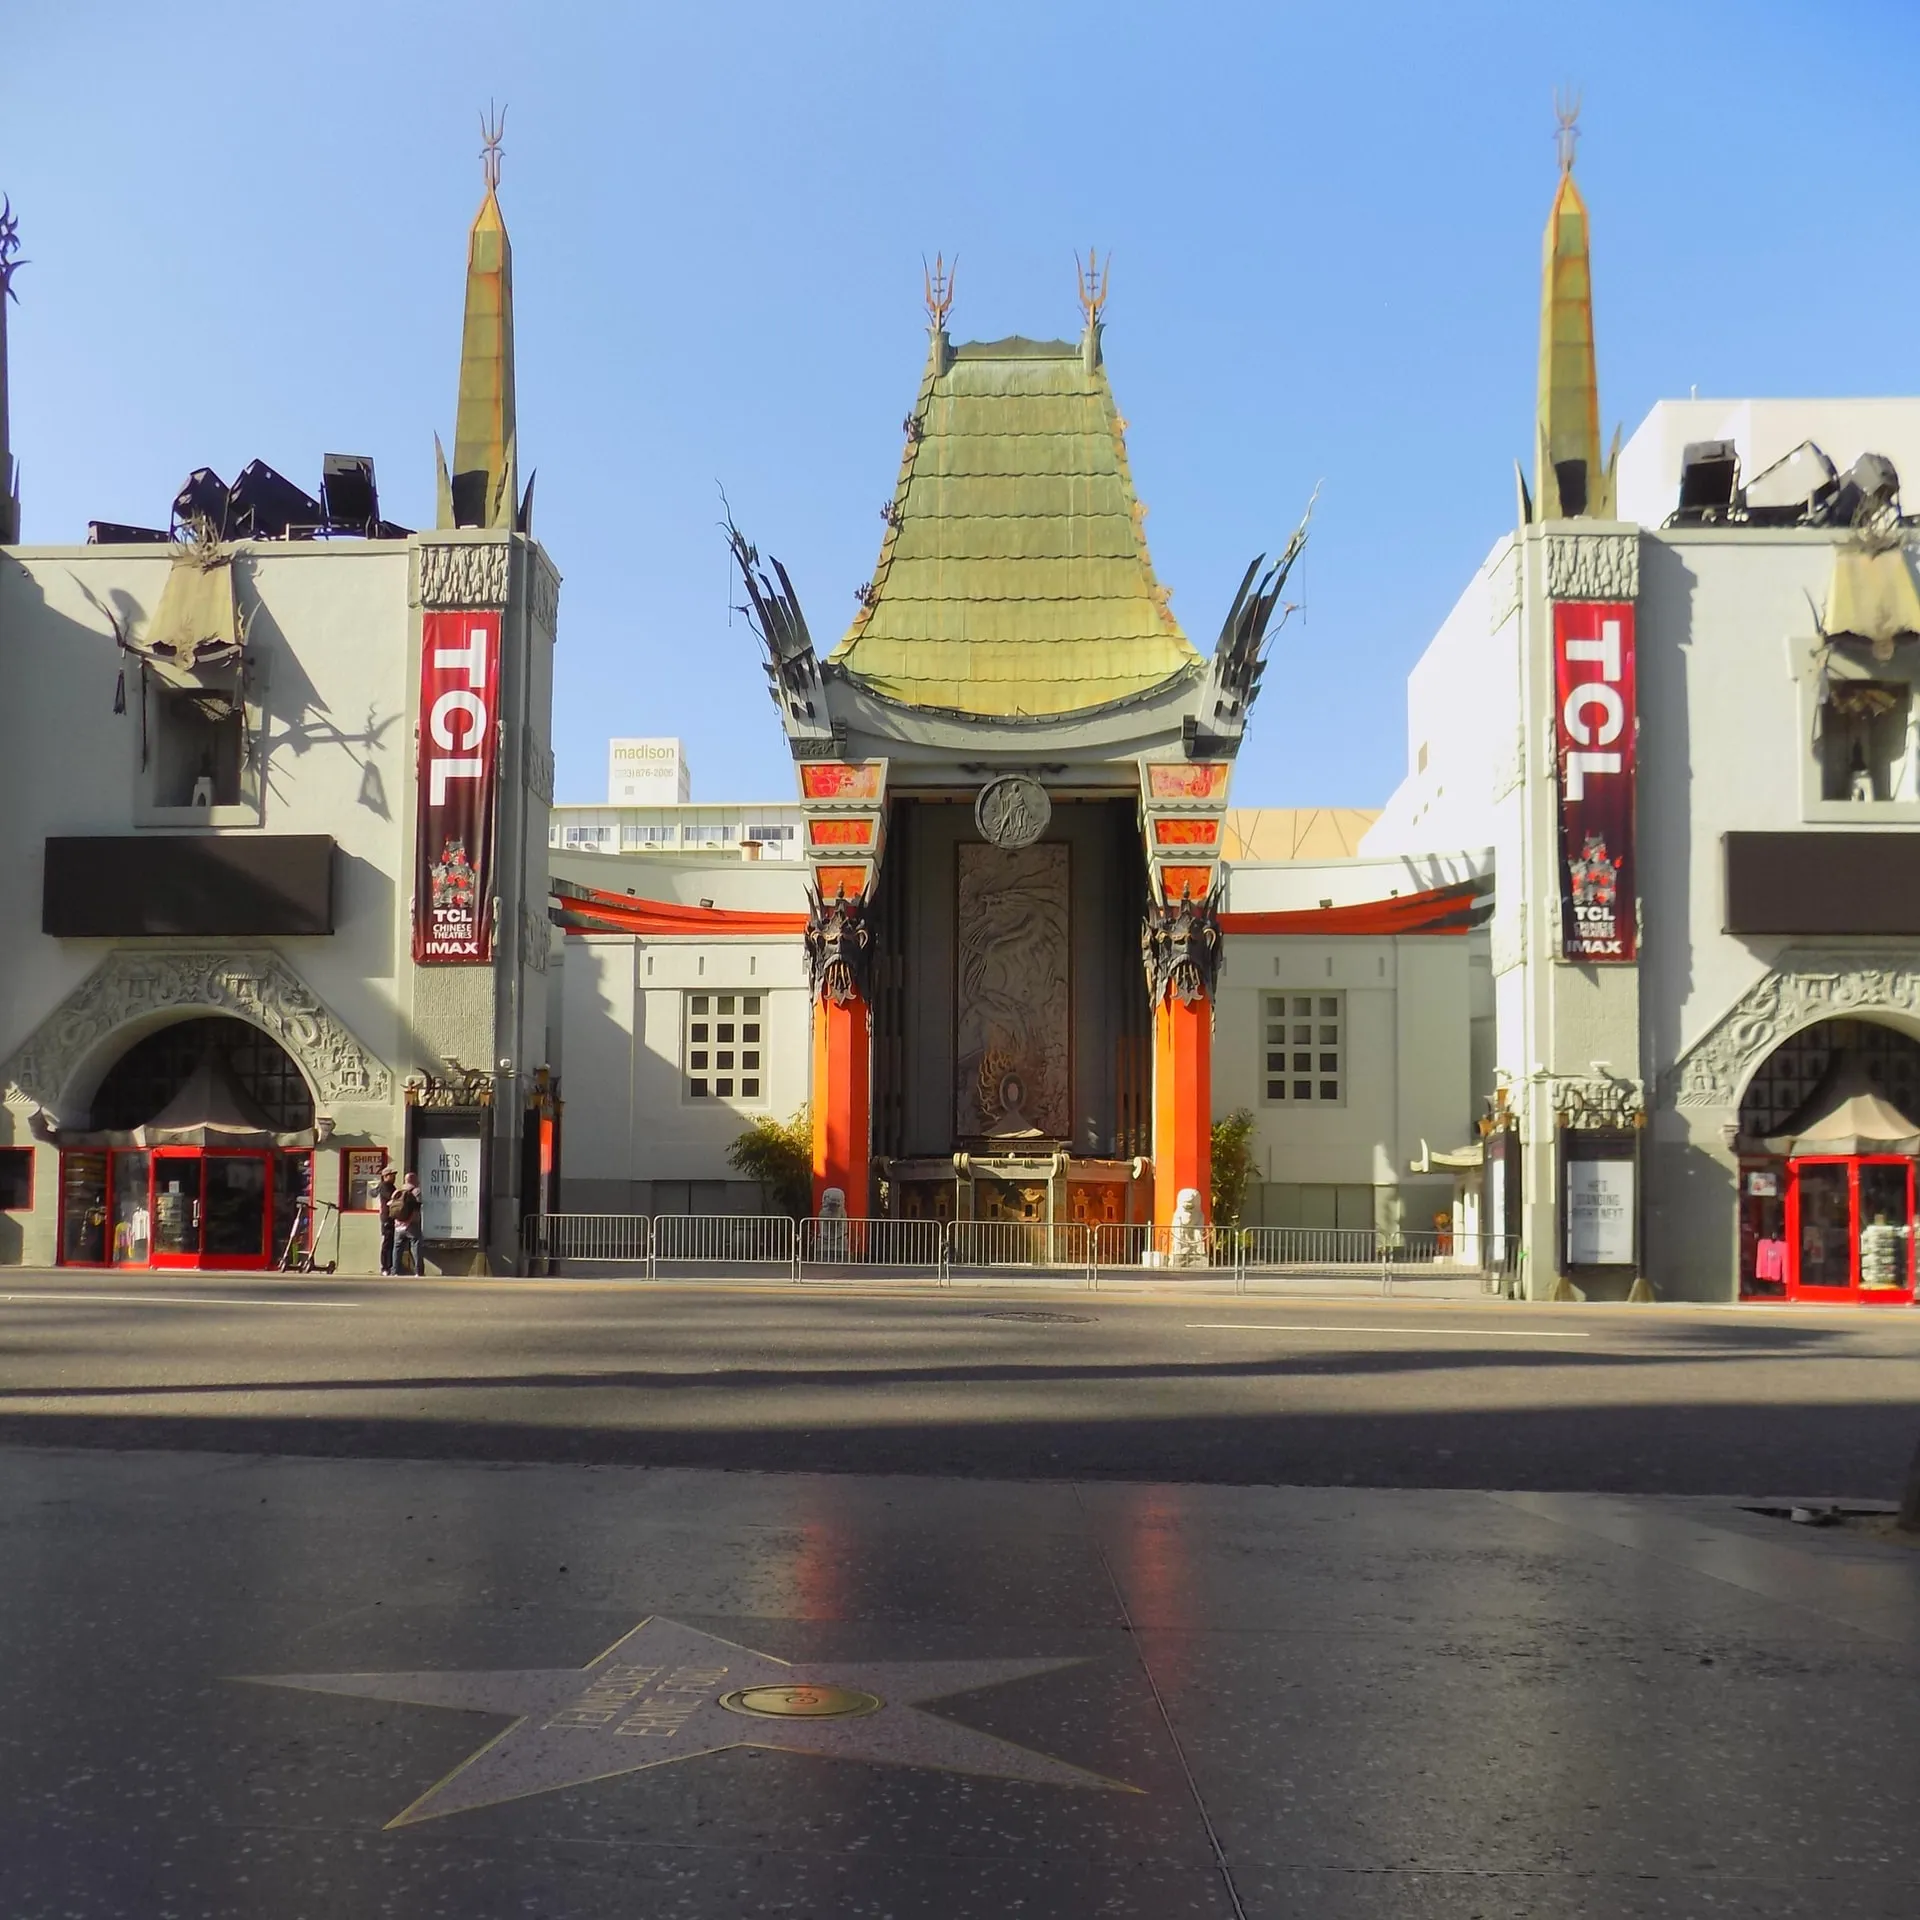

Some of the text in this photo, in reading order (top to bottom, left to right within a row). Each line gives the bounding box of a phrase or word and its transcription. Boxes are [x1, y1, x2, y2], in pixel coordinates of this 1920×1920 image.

[429, 628, 488, 807] TCL
[1563, 620, 1624, 802] TCL
[614, 744, 675, 760] madison
[433, 909, 473, 923] TCL
[1574, 906, 1616, 921] TCL
[433, 923, 472, 932] CHINESE
[426, 942, 479, 955] IMAX
[1567, 940, 1623, 954] IMAX
[353, 1155, 382, 1163] SHIRTS
[439, 1153, 460, 1168] HE'S
[431, 1170, 468, 1184] SITTING
[430, 1185, 468, 1199] IN YOUR
